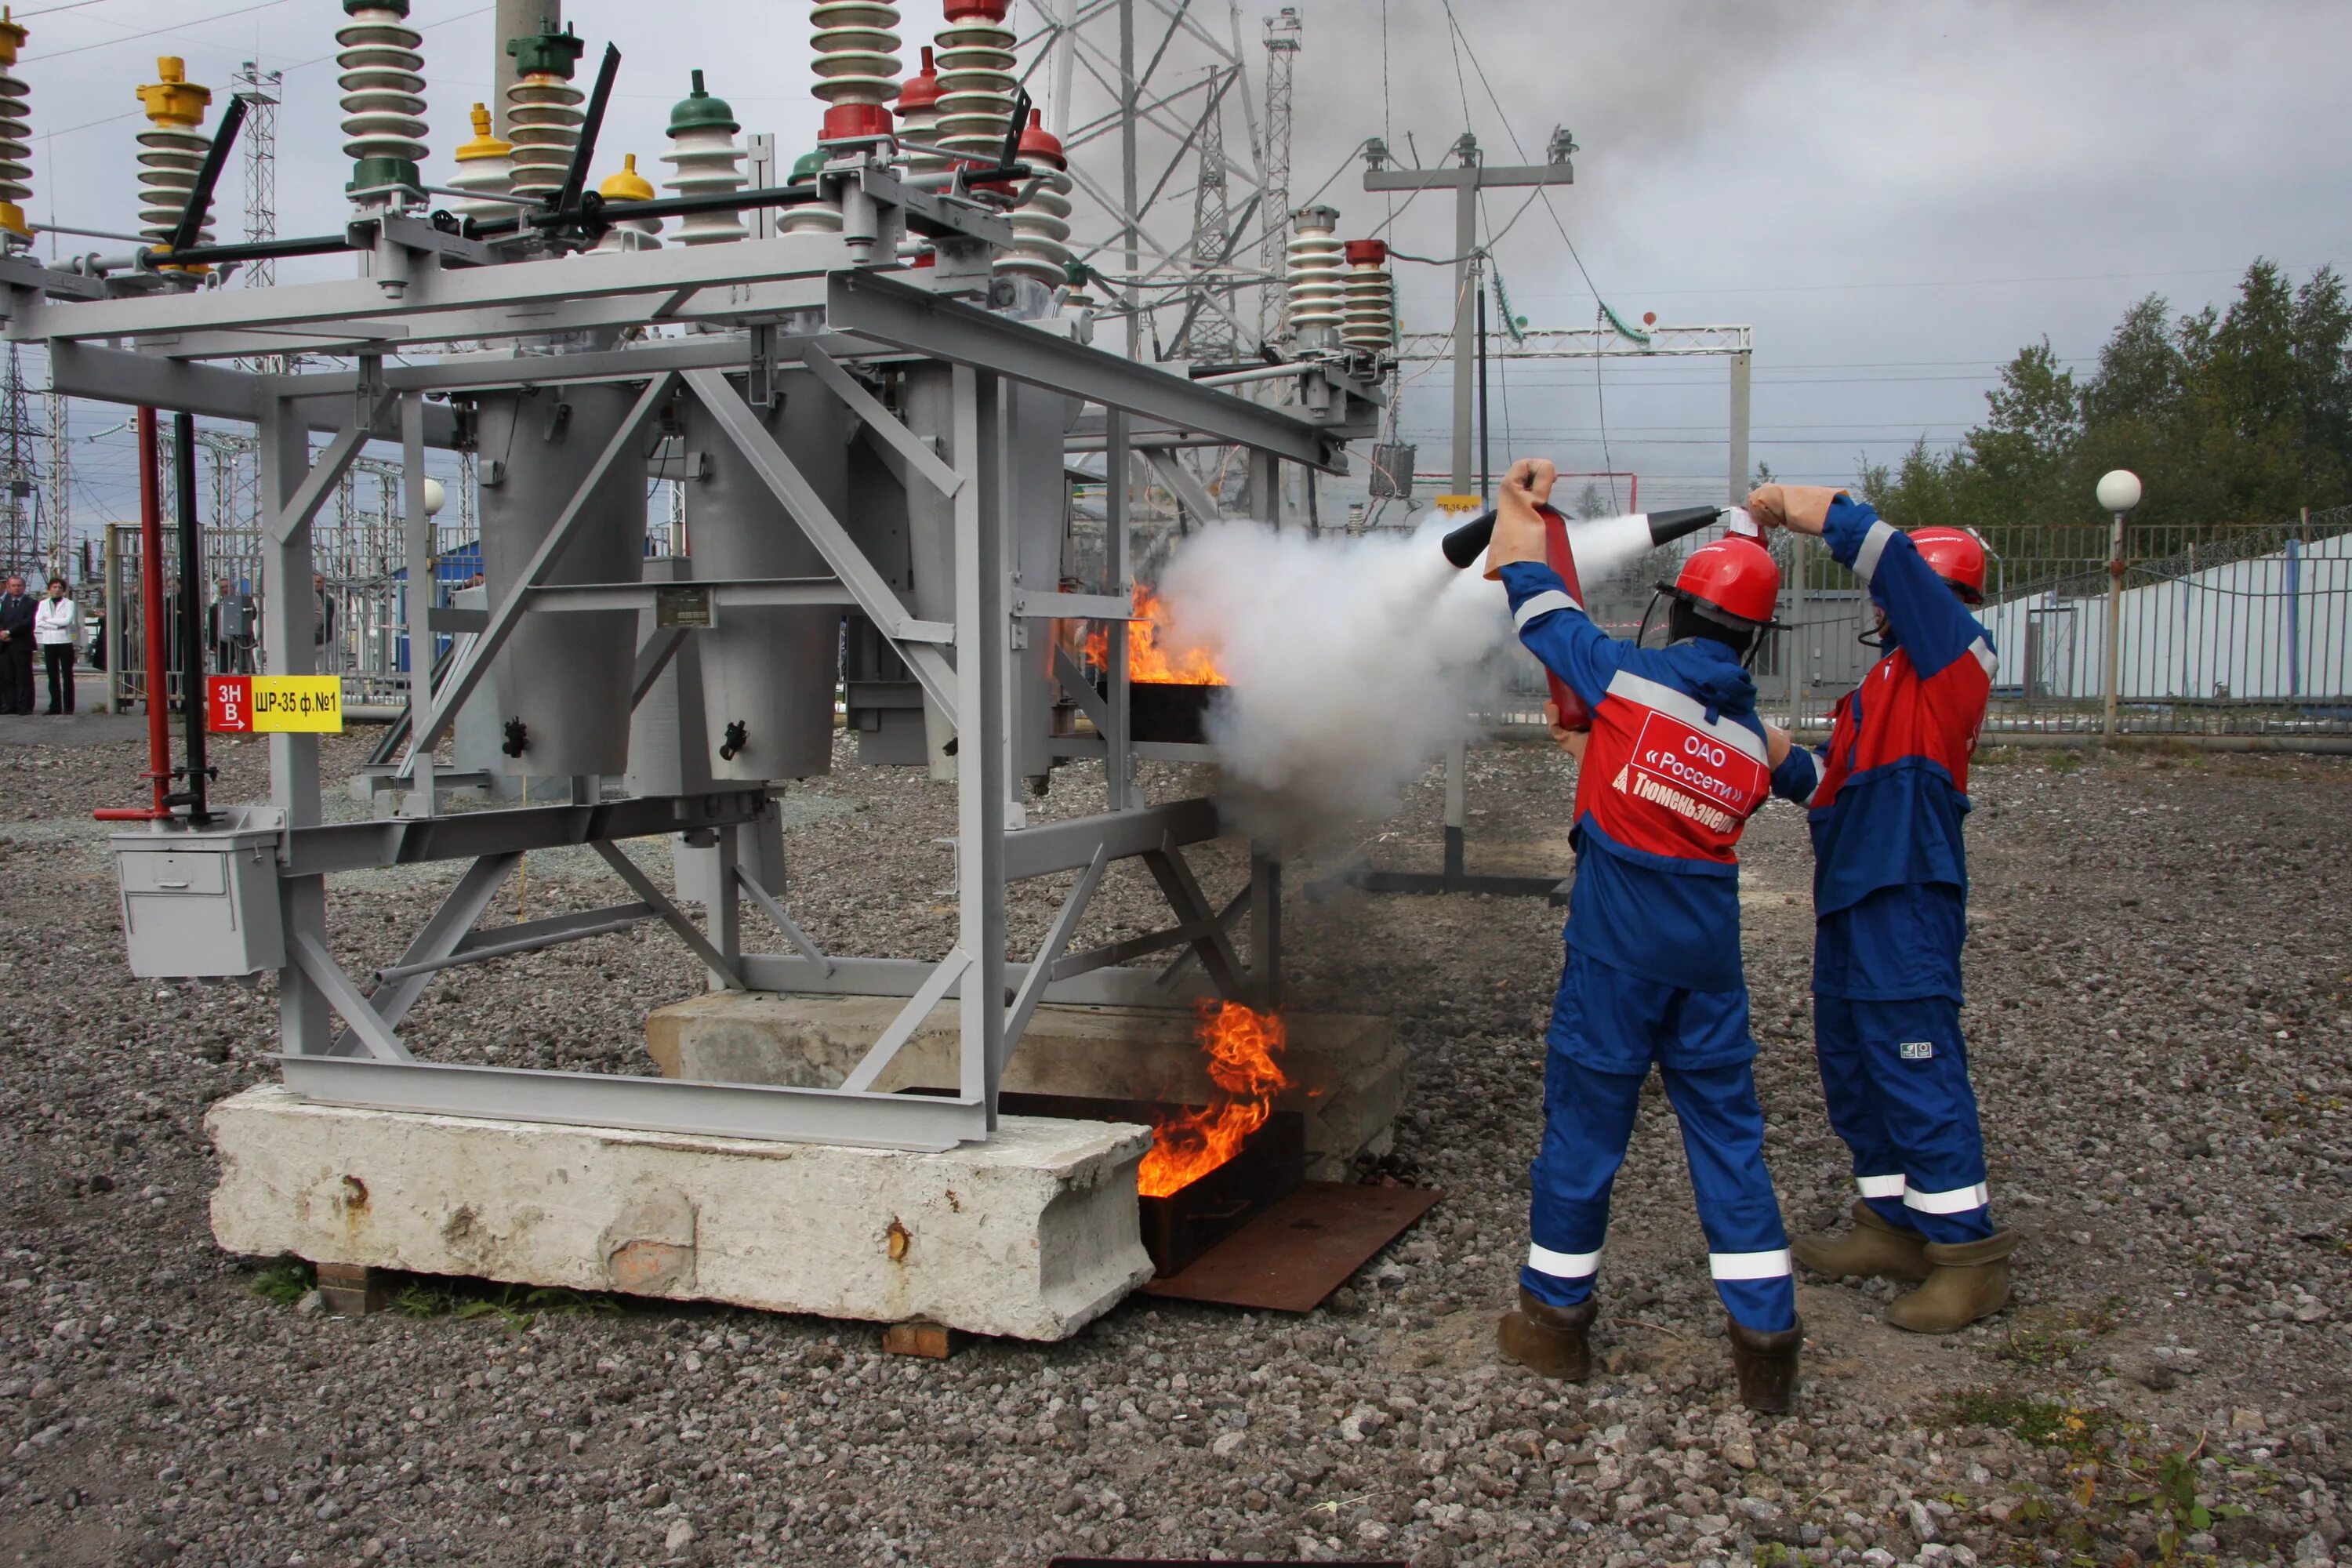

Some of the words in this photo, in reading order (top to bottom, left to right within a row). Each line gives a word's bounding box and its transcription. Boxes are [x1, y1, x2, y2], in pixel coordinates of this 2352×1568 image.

[225, 703, 238, 721] В
[256, 692, 296, 712] ШР-35
[300, 691, 336, 717] ф.№1
[1684, 735, 1726, 768] ОАО
[1646, 750, 1743, 802] «Россети»
[1633, 771, 1738, 834] Тюменьэнерг
